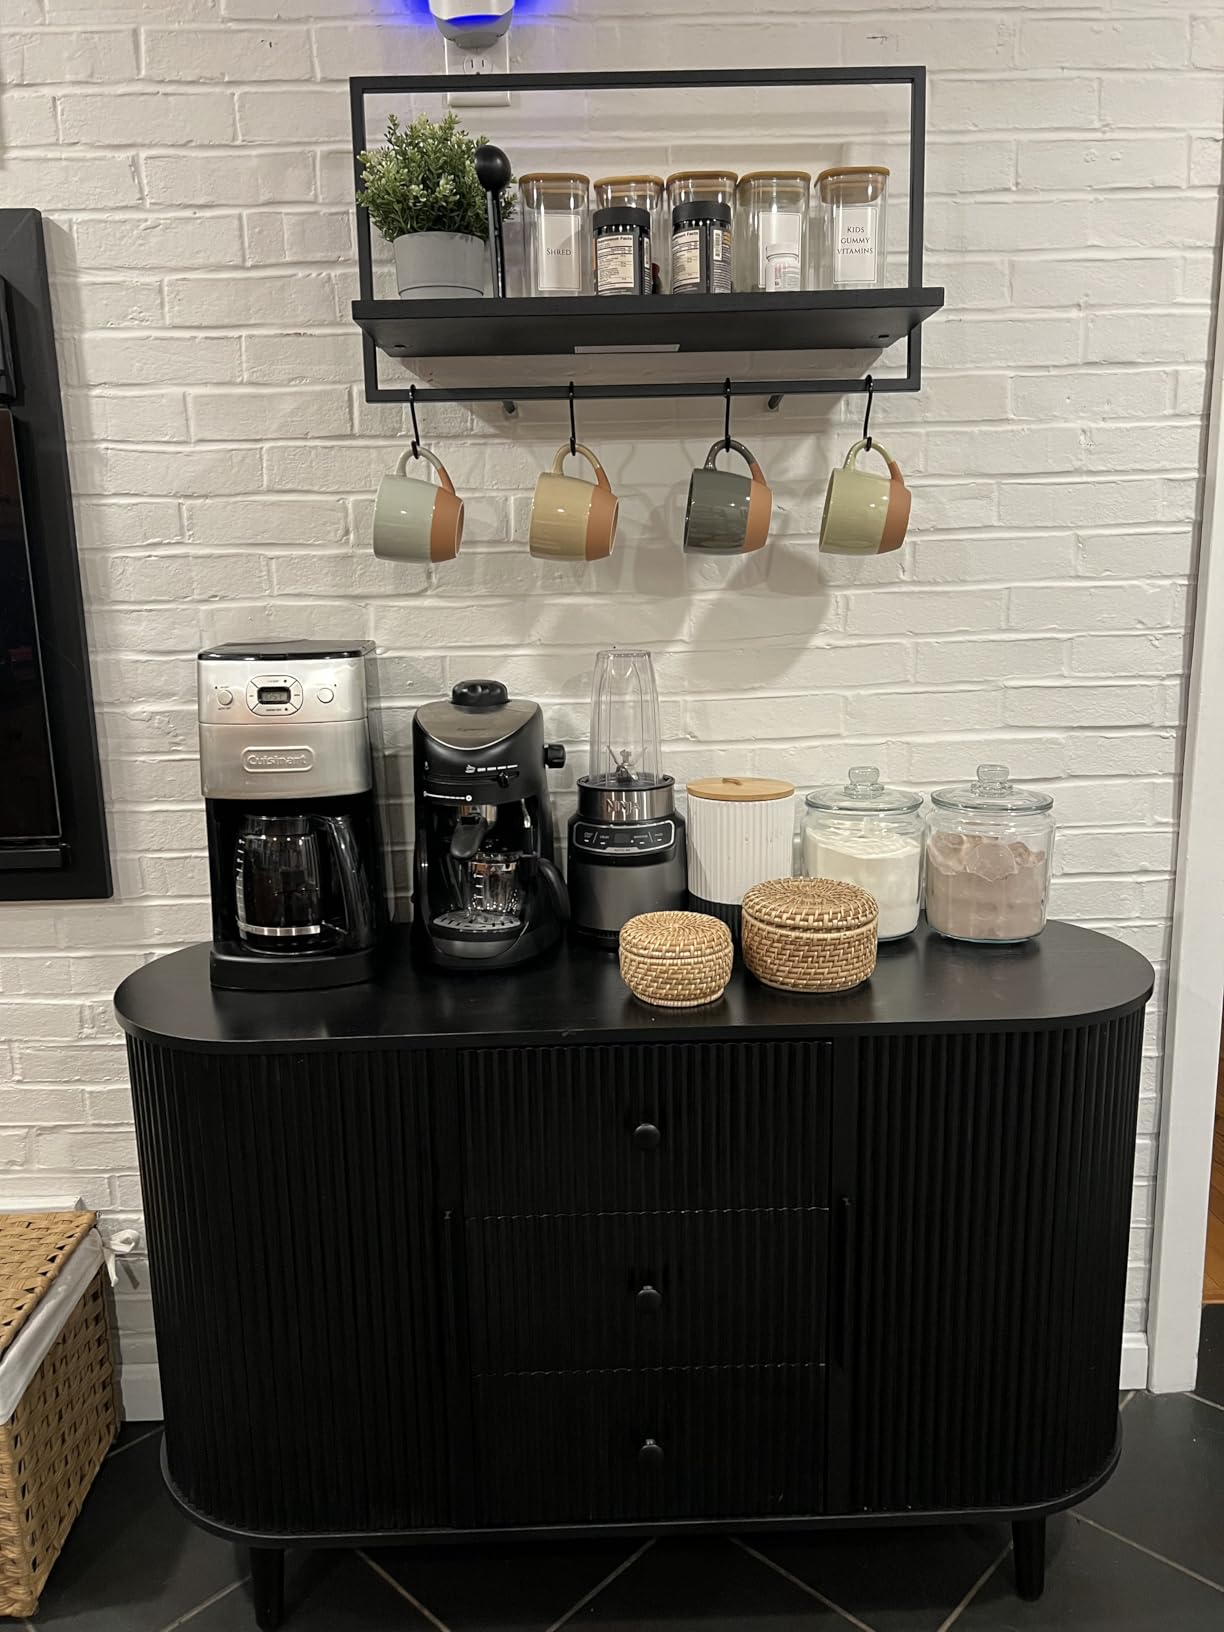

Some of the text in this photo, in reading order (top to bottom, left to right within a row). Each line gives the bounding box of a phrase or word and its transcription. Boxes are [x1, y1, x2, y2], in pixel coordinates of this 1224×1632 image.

[546, 248, 572, 256] SHRED
[837, 247, 873, 255] VITAMINS
[247, 754, 307, 765] Cuisinart
